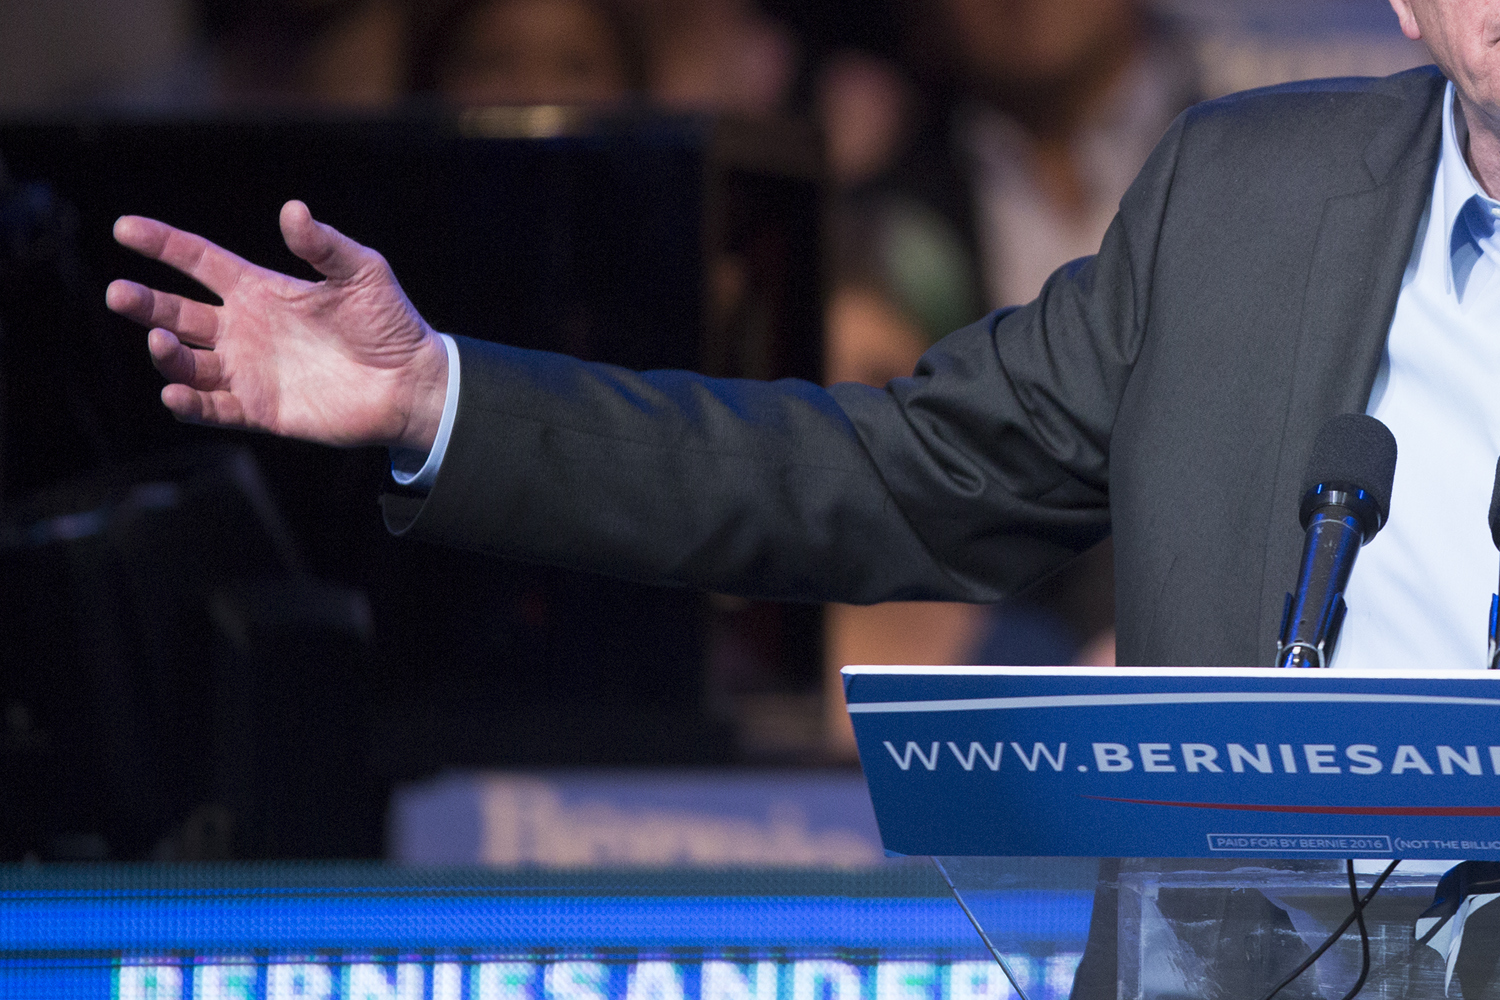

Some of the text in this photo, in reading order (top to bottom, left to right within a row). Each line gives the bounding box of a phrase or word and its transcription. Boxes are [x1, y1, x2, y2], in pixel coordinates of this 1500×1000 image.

[1217, 838, 1247, 847] PAID
[1250, 839, 1279, 847] FOR
[1280, 839, 1297, 847] BY
[1299, 839, 1347, 848] BERNIE
[1349, 840, 1383, 848] 2016
[1432, 841, 1460, 849] THE
